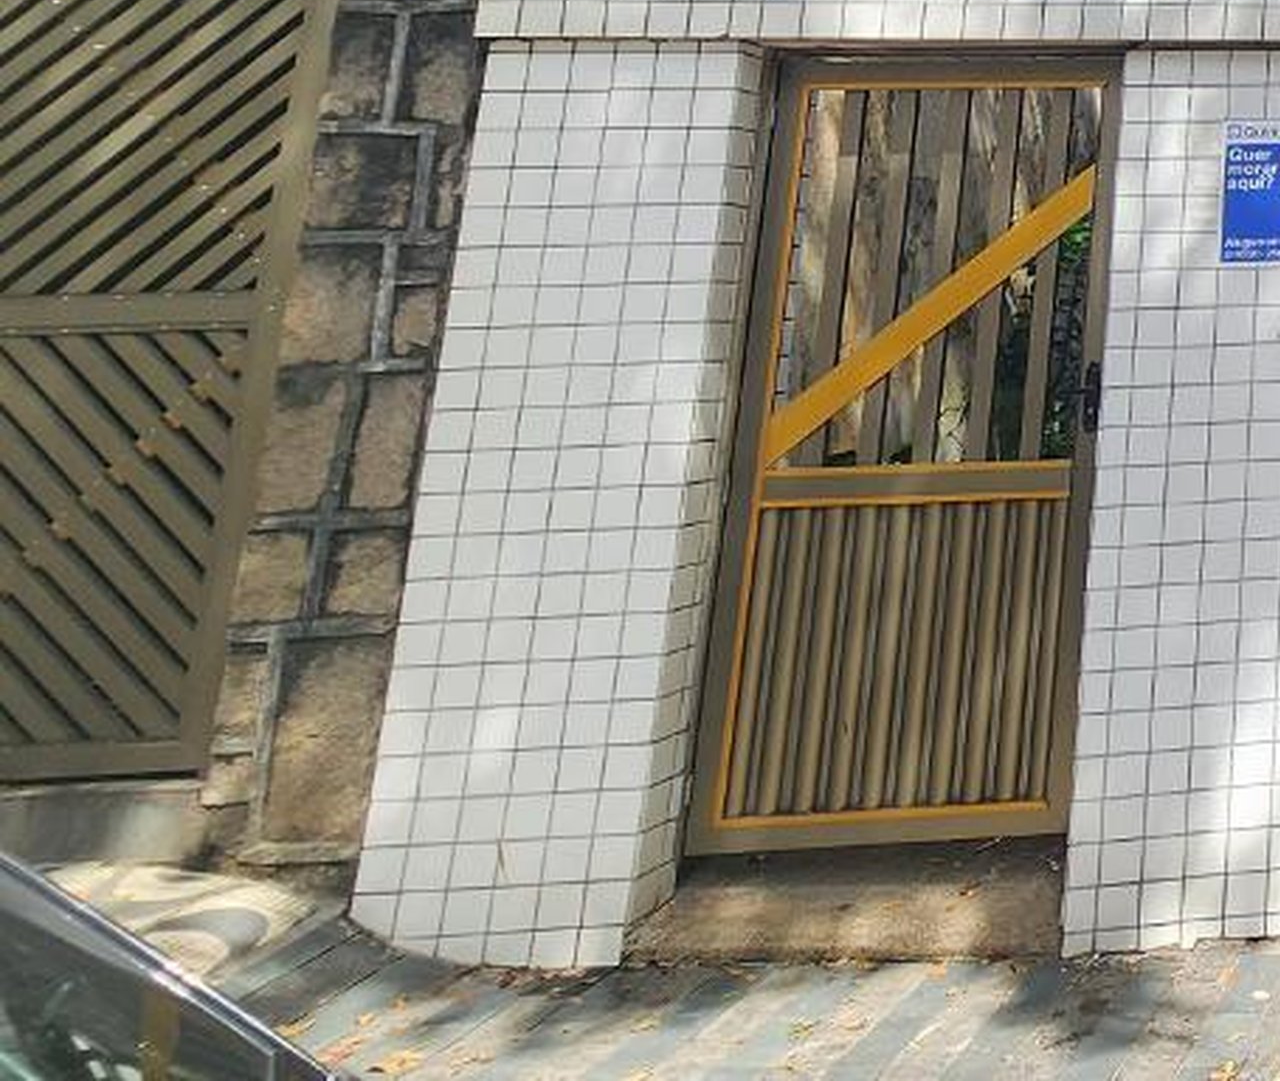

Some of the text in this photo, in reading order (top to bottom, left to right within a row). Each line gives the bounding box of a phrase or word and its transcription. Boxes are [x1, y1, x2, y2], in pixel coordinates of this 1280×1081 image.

[1229, 148, 1271, 161] Quer
[1227, 164, 1278, 176] morar
[1227, 176, 1274, 191] aqui?
